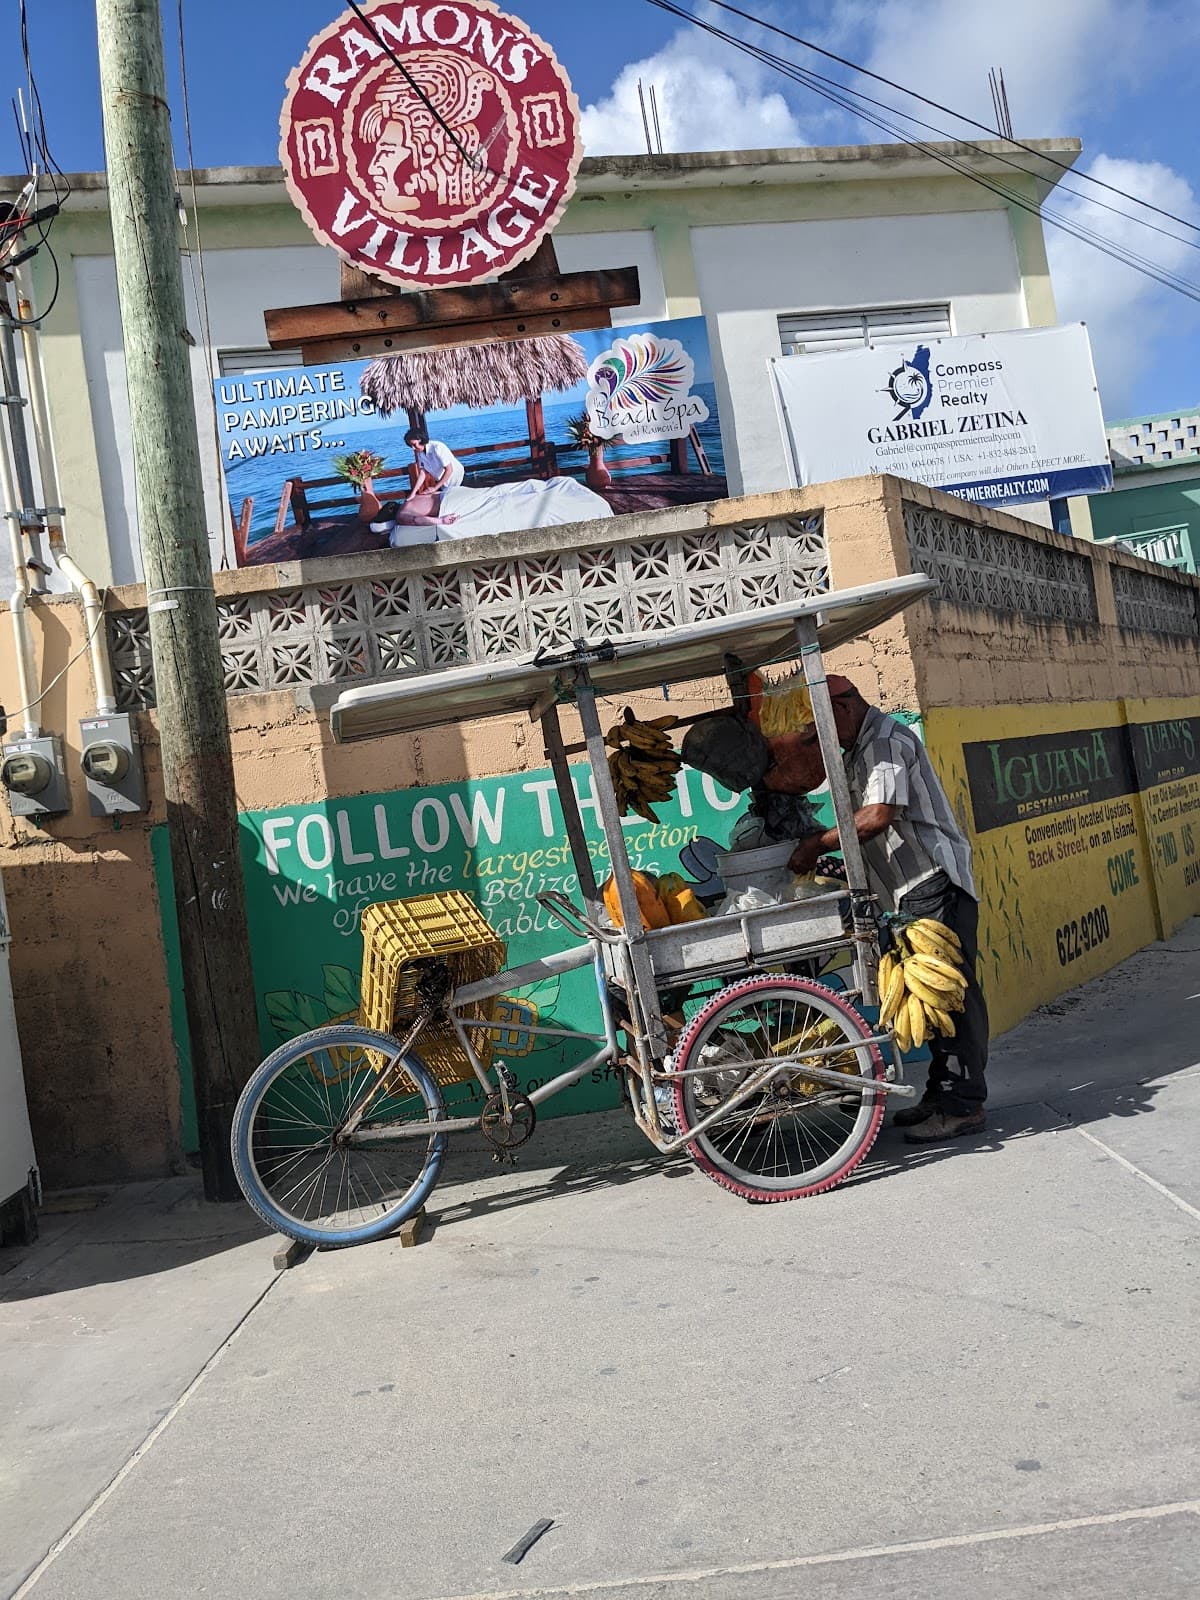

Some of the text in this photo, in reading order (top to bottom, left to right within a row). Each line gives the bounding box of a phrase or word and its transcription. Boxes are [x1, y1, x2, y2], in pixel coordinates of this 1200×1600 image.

[303, 5, 542, 107] RAMON'S
[332, 165, 559, 276] VILLAGE
[935, 360, 1003, 377] Compass
[938, 375, 996, 392] Premier
[220, 370, 345, 405] ULTIMATE
[940, 391, 988, 407] Realty
[223, 396, 376, 433] PAMPERING
[596, 397, 702, 430] Beach Spa
[867, 410, 1028, 444] GABRIEL ZETINA
[227, 429, 346, 460] AWAITS...
[875, 432, 1021, 457] Gabriel@compasspremierrealty.com
[953, 454, 974, 463] USA:
[946, 470, 978, 480] company
[979, 467, 992, 475] will
[1006, 463, 1029, 472] Others
[1031, 458, 1061, 469] EXPECT
[986, 720, 1196, 805] IGUANA JUAN'S
[262, 787, 506, 876] FOLLOW
[1024, 814, 1077, 845] Conveniently
[1077, 806, 1105, 830] located
[1104, 800, 1134, 821] Upstairs,
[1028, 844, 1056, 870] Back
[1056, 837, 1089, 861] Street,
[1089, 833, 1100, 849] on
[1101, 829, 1112, 845] an
[1112, 818, 1138, 841] Island,
[1157, 801, 1179, 822] Central
[273, 823, 700, 907] We have the largest seection
[1106, 847, 1140, 897] COME
[1180, 823, 1195, 857] US
[480, 873, 577, 907] Belize
[1055, 904, 1110, 968] 622-9200
